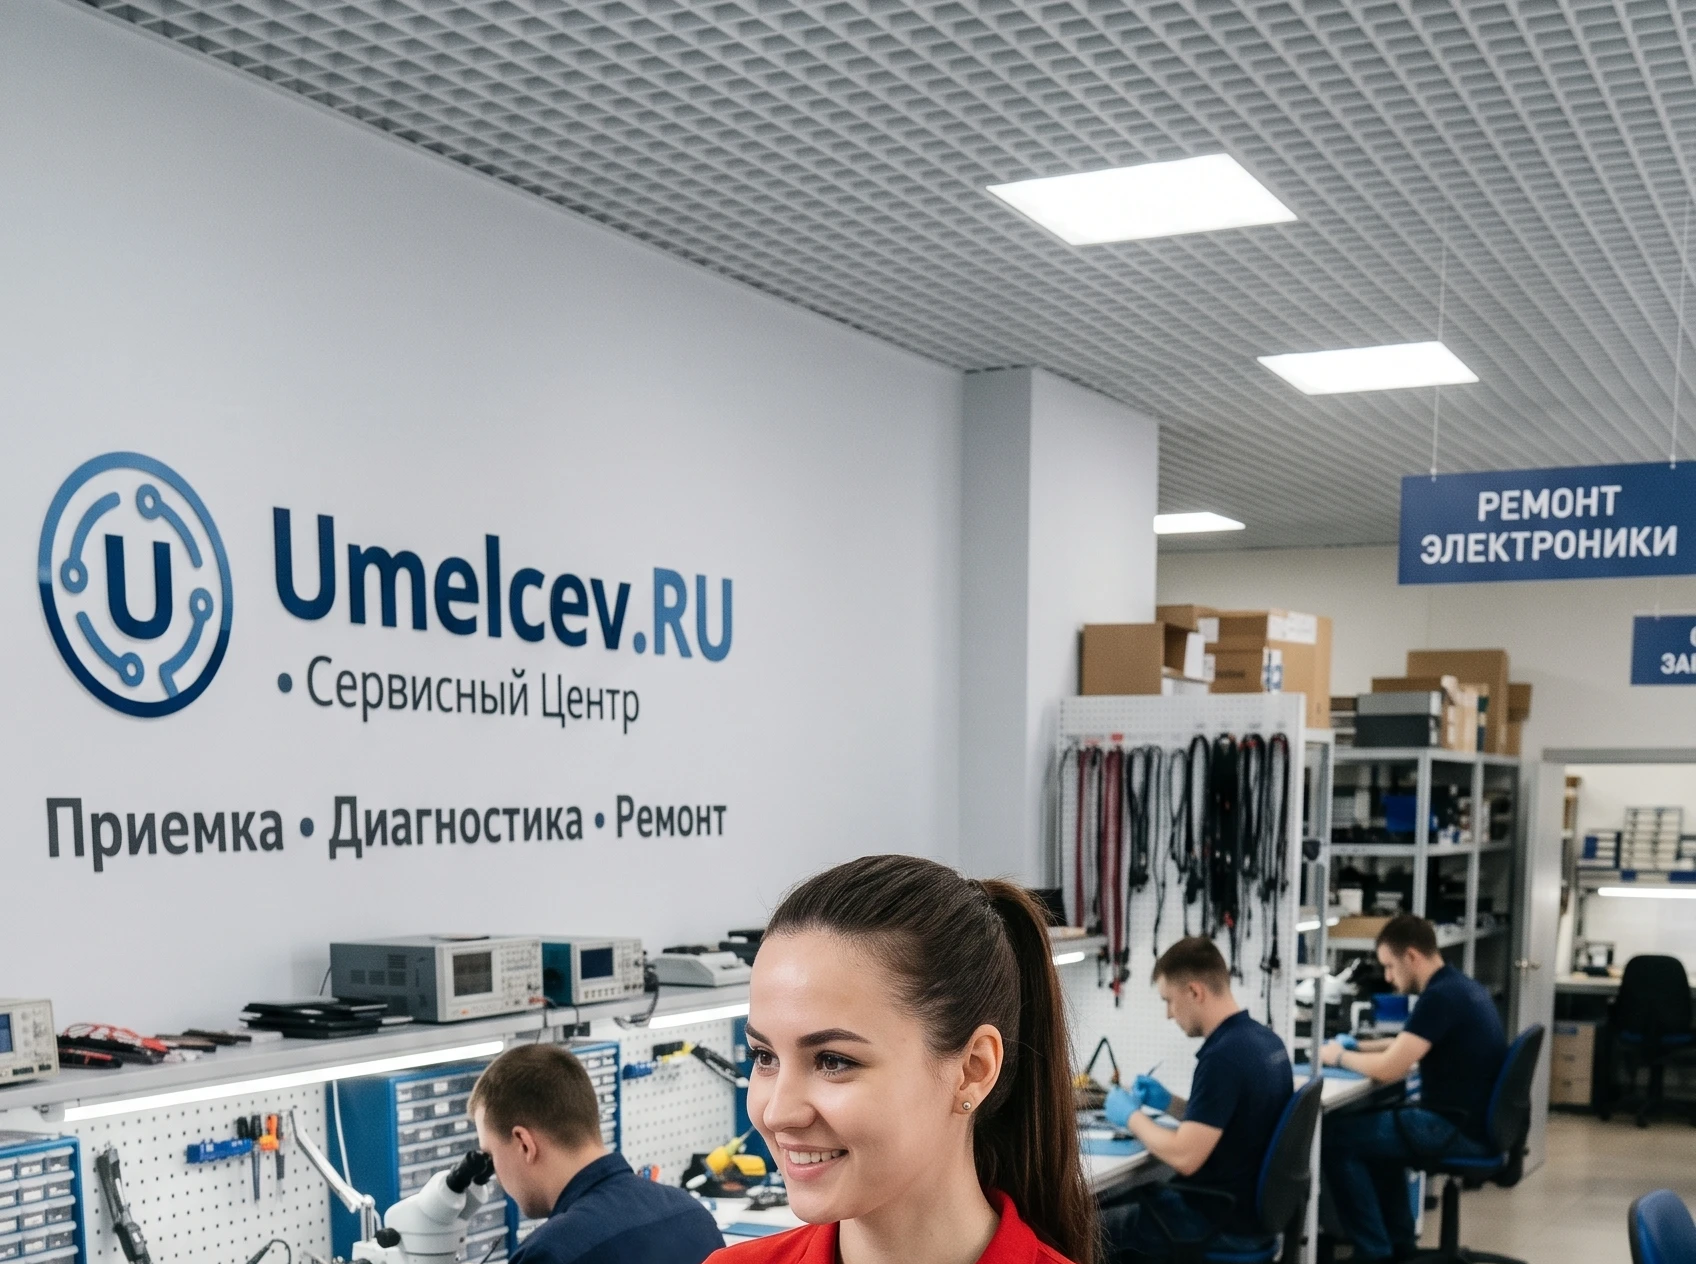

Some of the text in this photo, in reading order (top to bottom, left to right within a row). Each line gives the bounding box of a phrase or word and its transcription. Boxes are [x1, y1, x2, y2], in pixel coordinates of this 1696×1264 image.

[1478, 485, 1622, 522] РЕМОНТ
[272, 506, 734, 662] Umelcev.RU
[1420, 525, 1678, 565] ЭЛЕКТРОНИКИ
[104, 533, 174, 640] U
[306, 655, 641, 734] Сервисный Центр
[45, 794, 728, 873] Приемка Диагностика Ремонт
